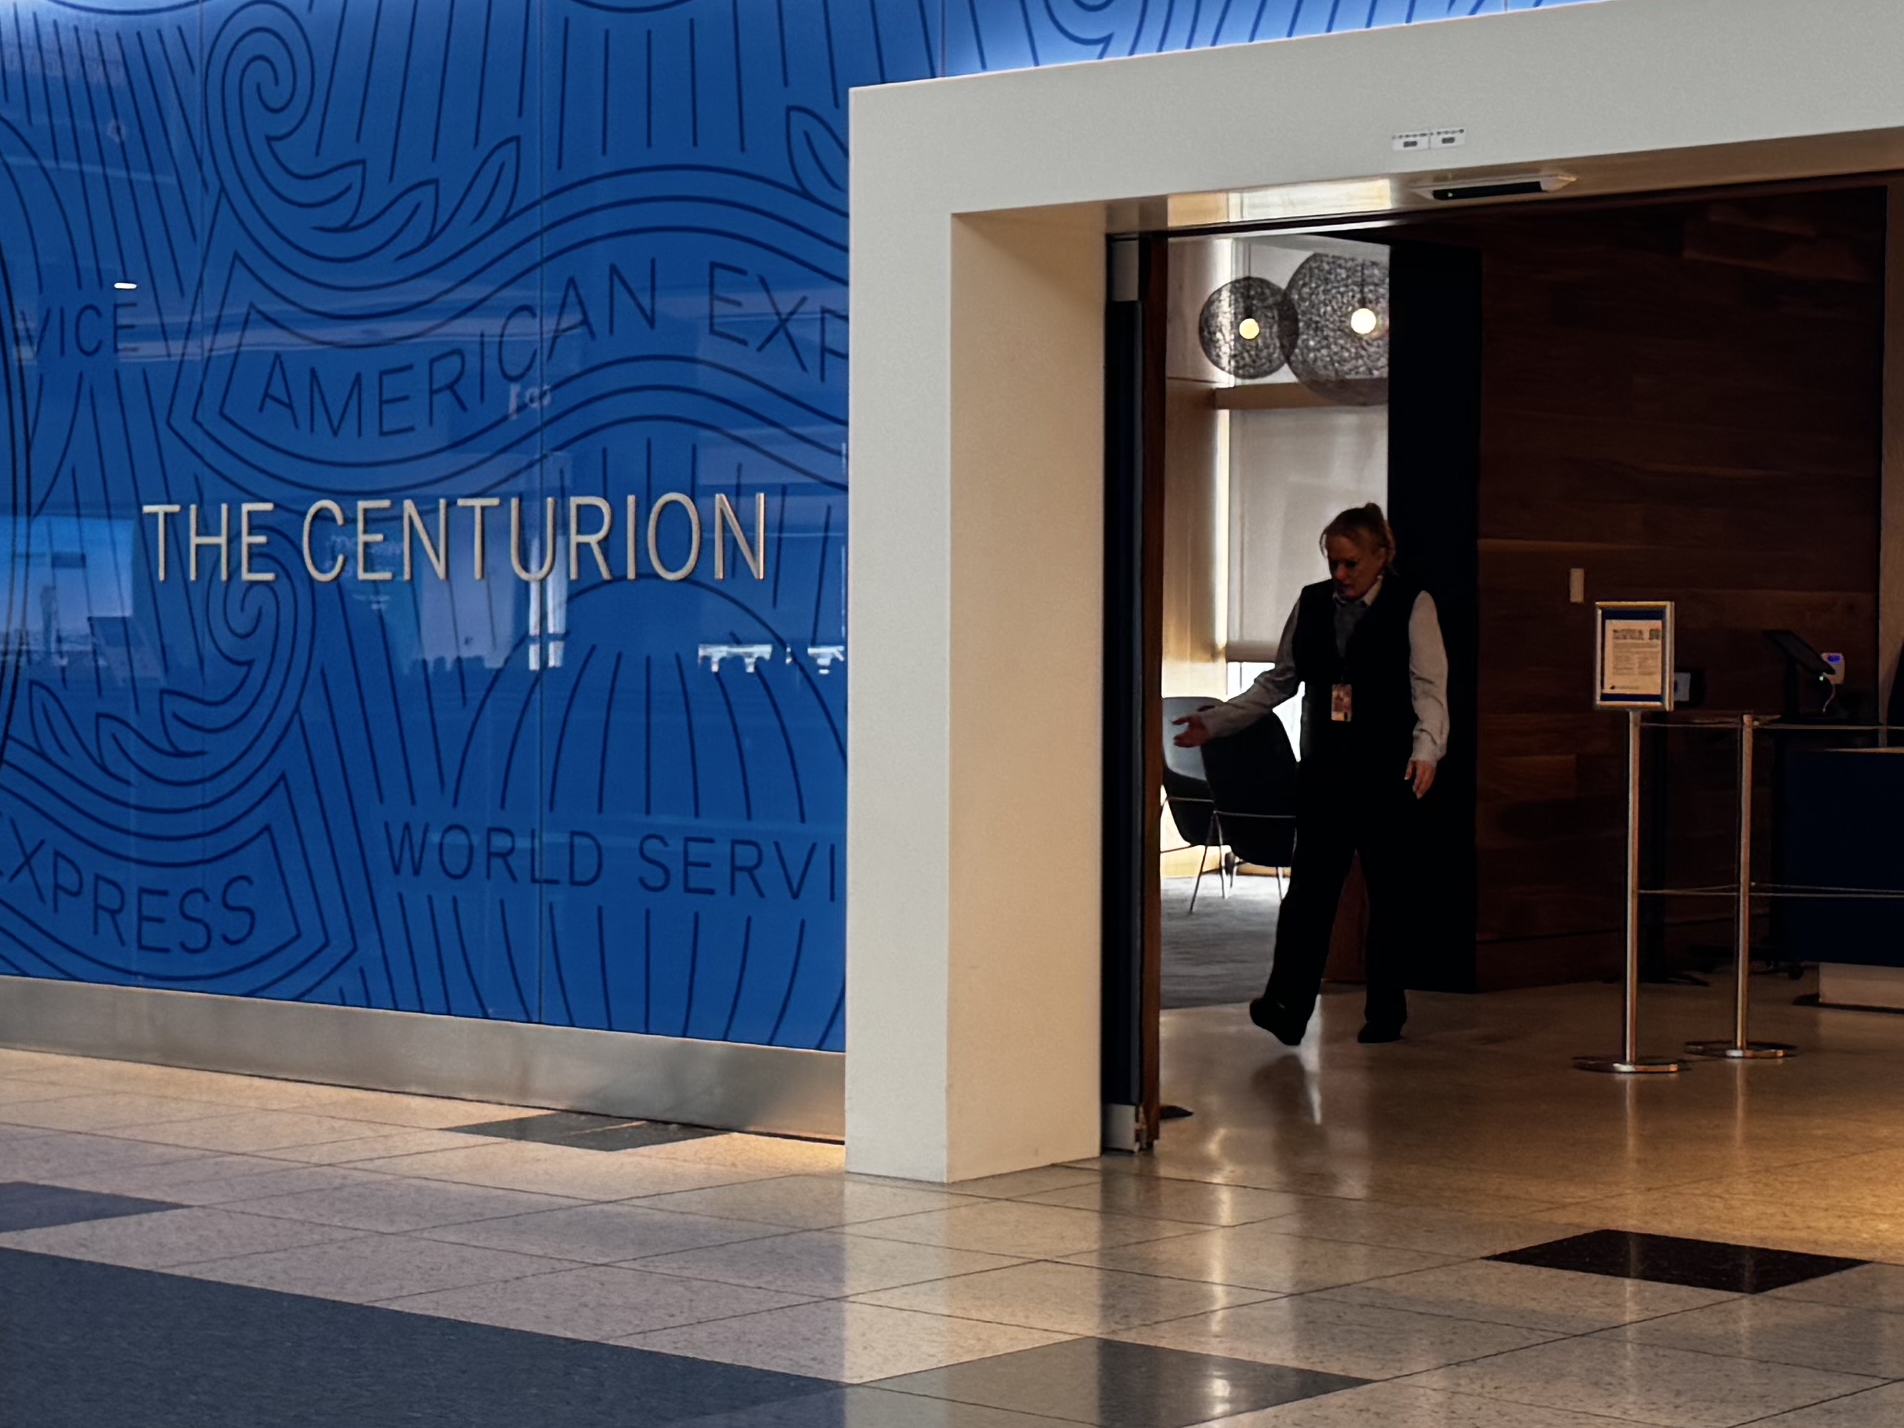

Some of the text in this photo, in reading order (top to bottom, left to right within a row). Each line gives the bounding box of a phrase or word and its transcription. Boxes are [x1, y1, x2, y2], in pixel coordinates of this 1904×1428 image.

[258, 257, 656, 439] AMERICAN
[142, 491, 766, 583] THE CENTURION
[384, 820, 604, 887] WORLD
